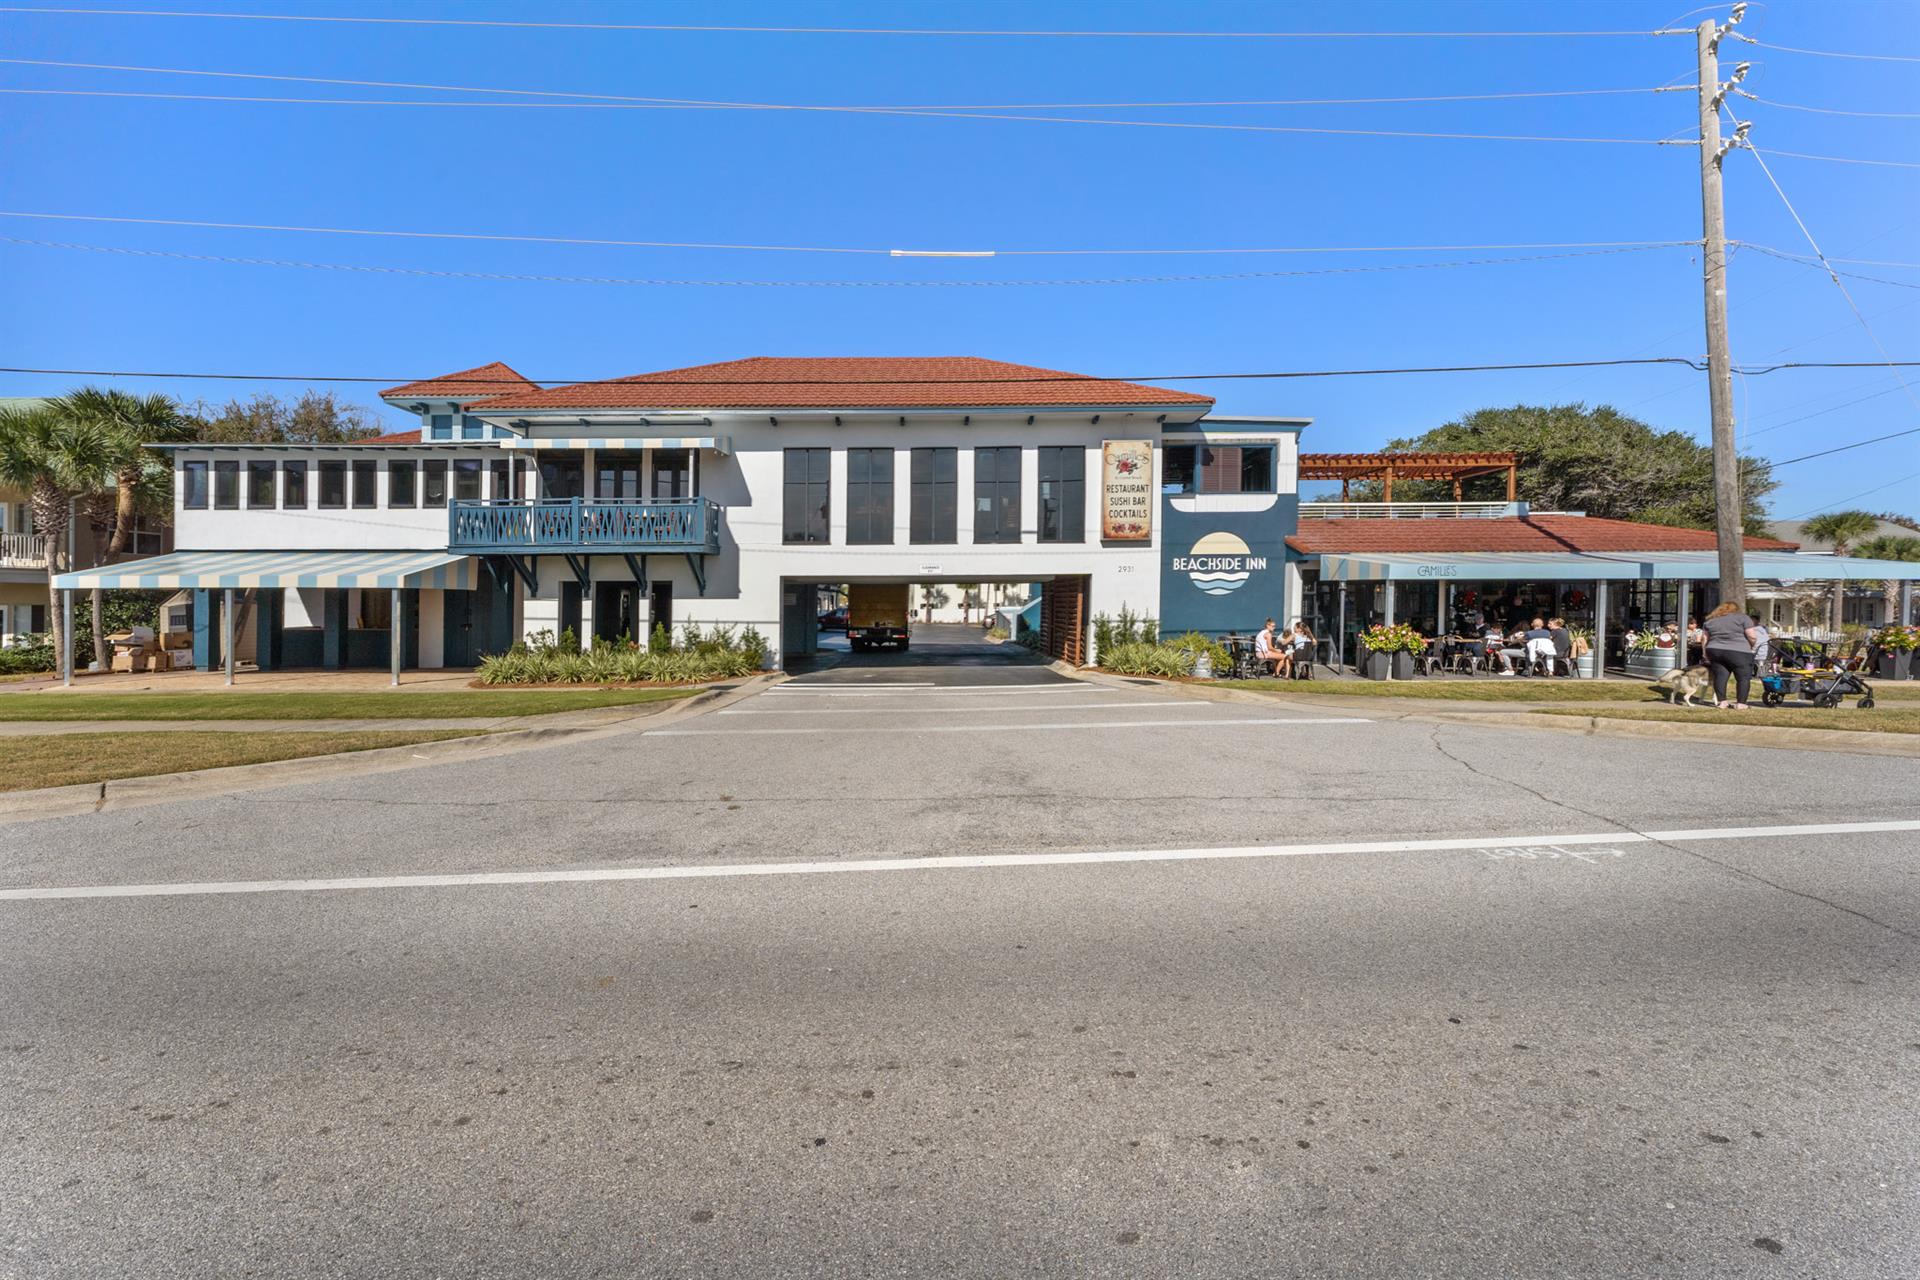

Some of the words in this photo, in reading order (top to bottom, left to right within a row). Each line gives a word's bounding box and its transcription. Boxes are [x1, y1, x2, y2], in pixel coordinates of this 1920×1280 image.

[1106, 484, 1150, 493] RESTAURANT
[1110, 497, 1130, 506] SUSHI
[1133, 497, 1146, 506] BAR
[1109, 510, 1147, 518] COCKTAILS
[1173, 557, 1241, 570] BEACHSIDE
[1246, 557, 1266, 570] INN
